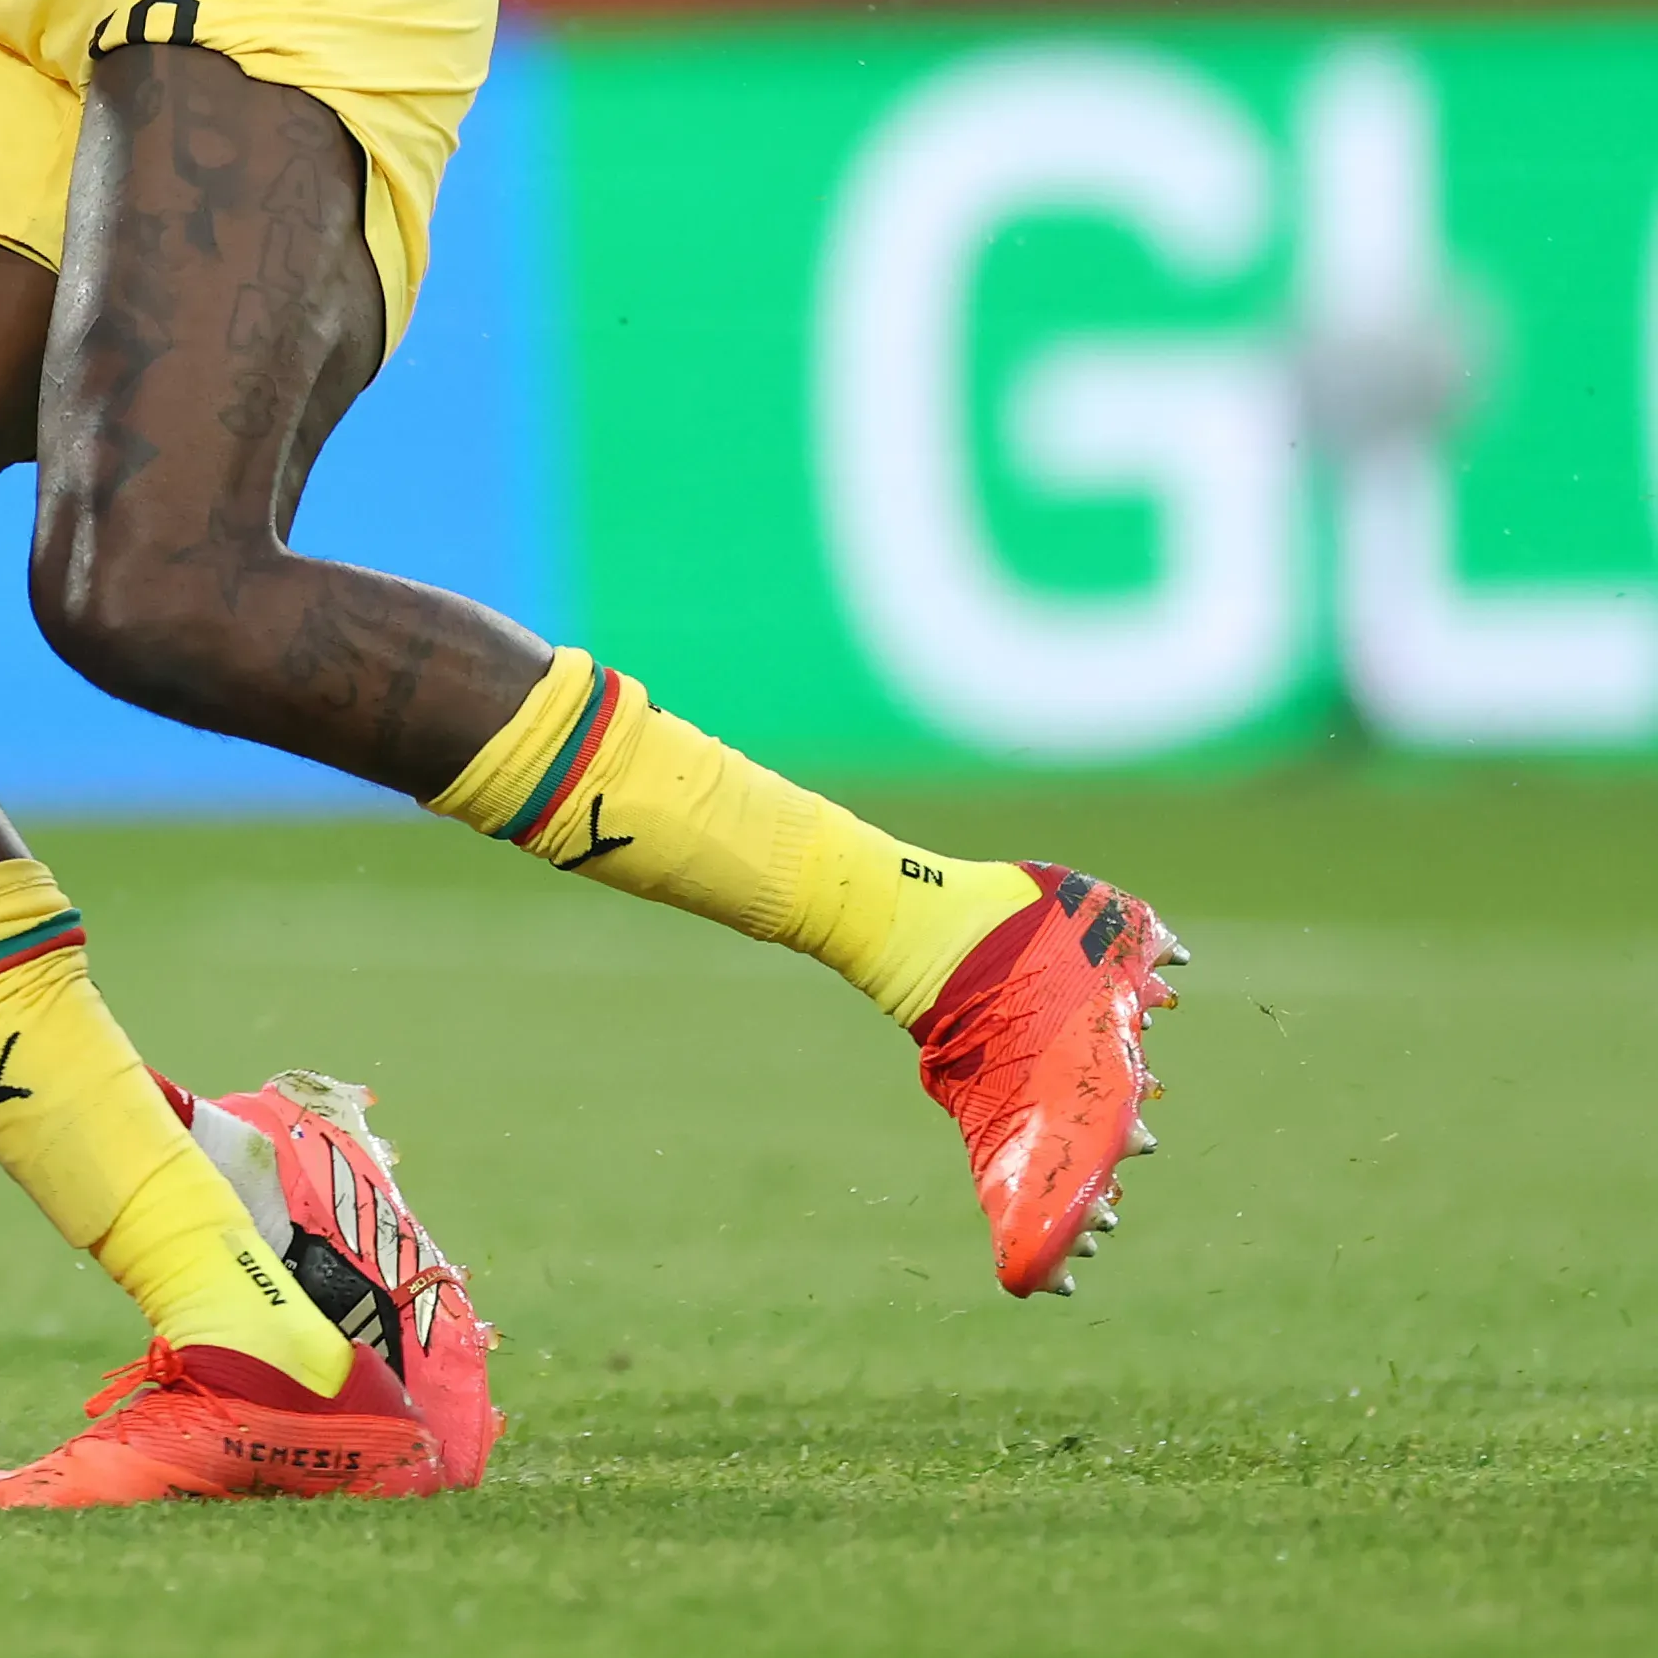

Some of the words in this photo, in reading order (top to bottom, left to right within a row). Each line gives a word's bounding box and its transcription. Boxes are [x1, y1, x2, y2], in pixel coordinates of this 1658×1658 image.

[808, 34, 1658, 767] GL
[901, 857, 944, 888] GN
[223, 1436, 361, 1470] NEMESIS
